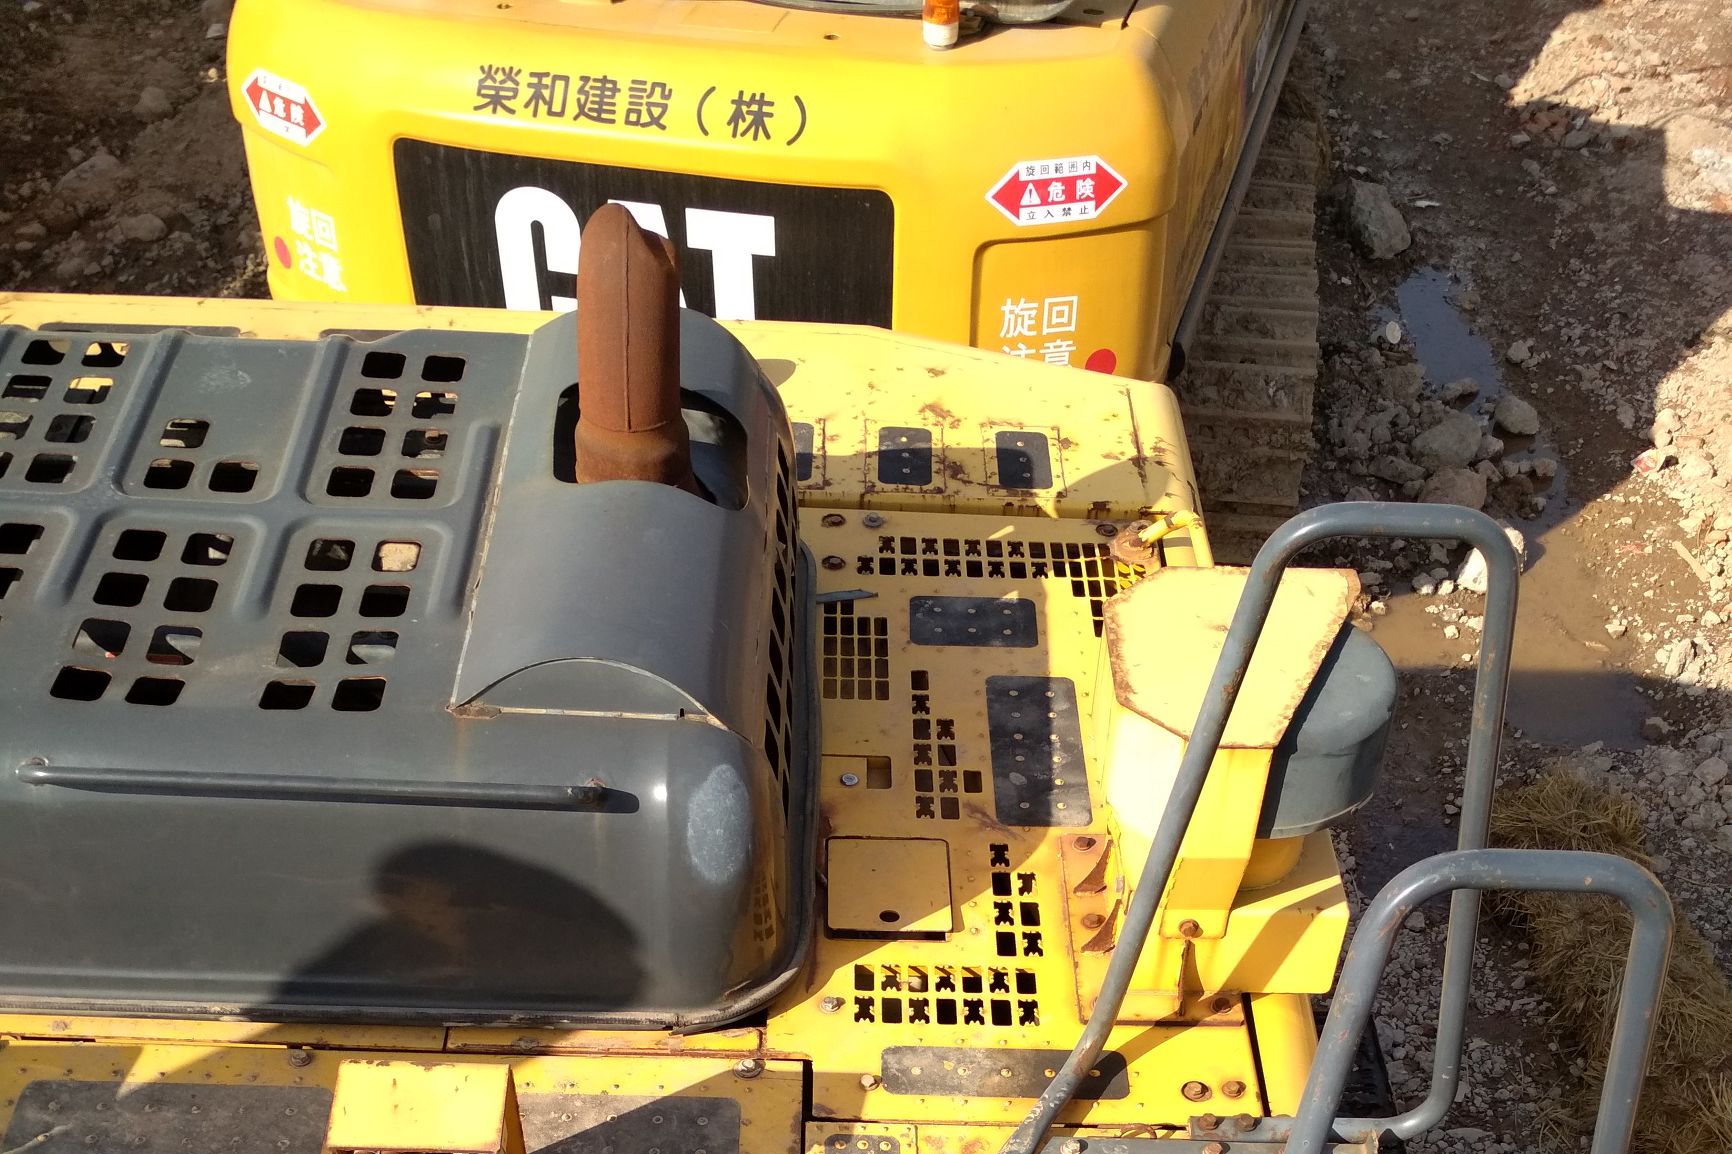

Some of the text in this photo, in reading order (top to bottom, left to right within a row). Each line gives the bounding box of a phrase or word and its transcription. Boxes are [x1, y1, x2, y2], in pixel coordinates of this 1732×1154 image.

[1026, 160, 1091, 176] 旋回範囲内
[1047, 178, 1096, 203] 危険
[1026, 205, 1090, 220] 立入禁止
[495, 186, 776, 321] CT
[1000, 295, 1078, 338] 旋回
